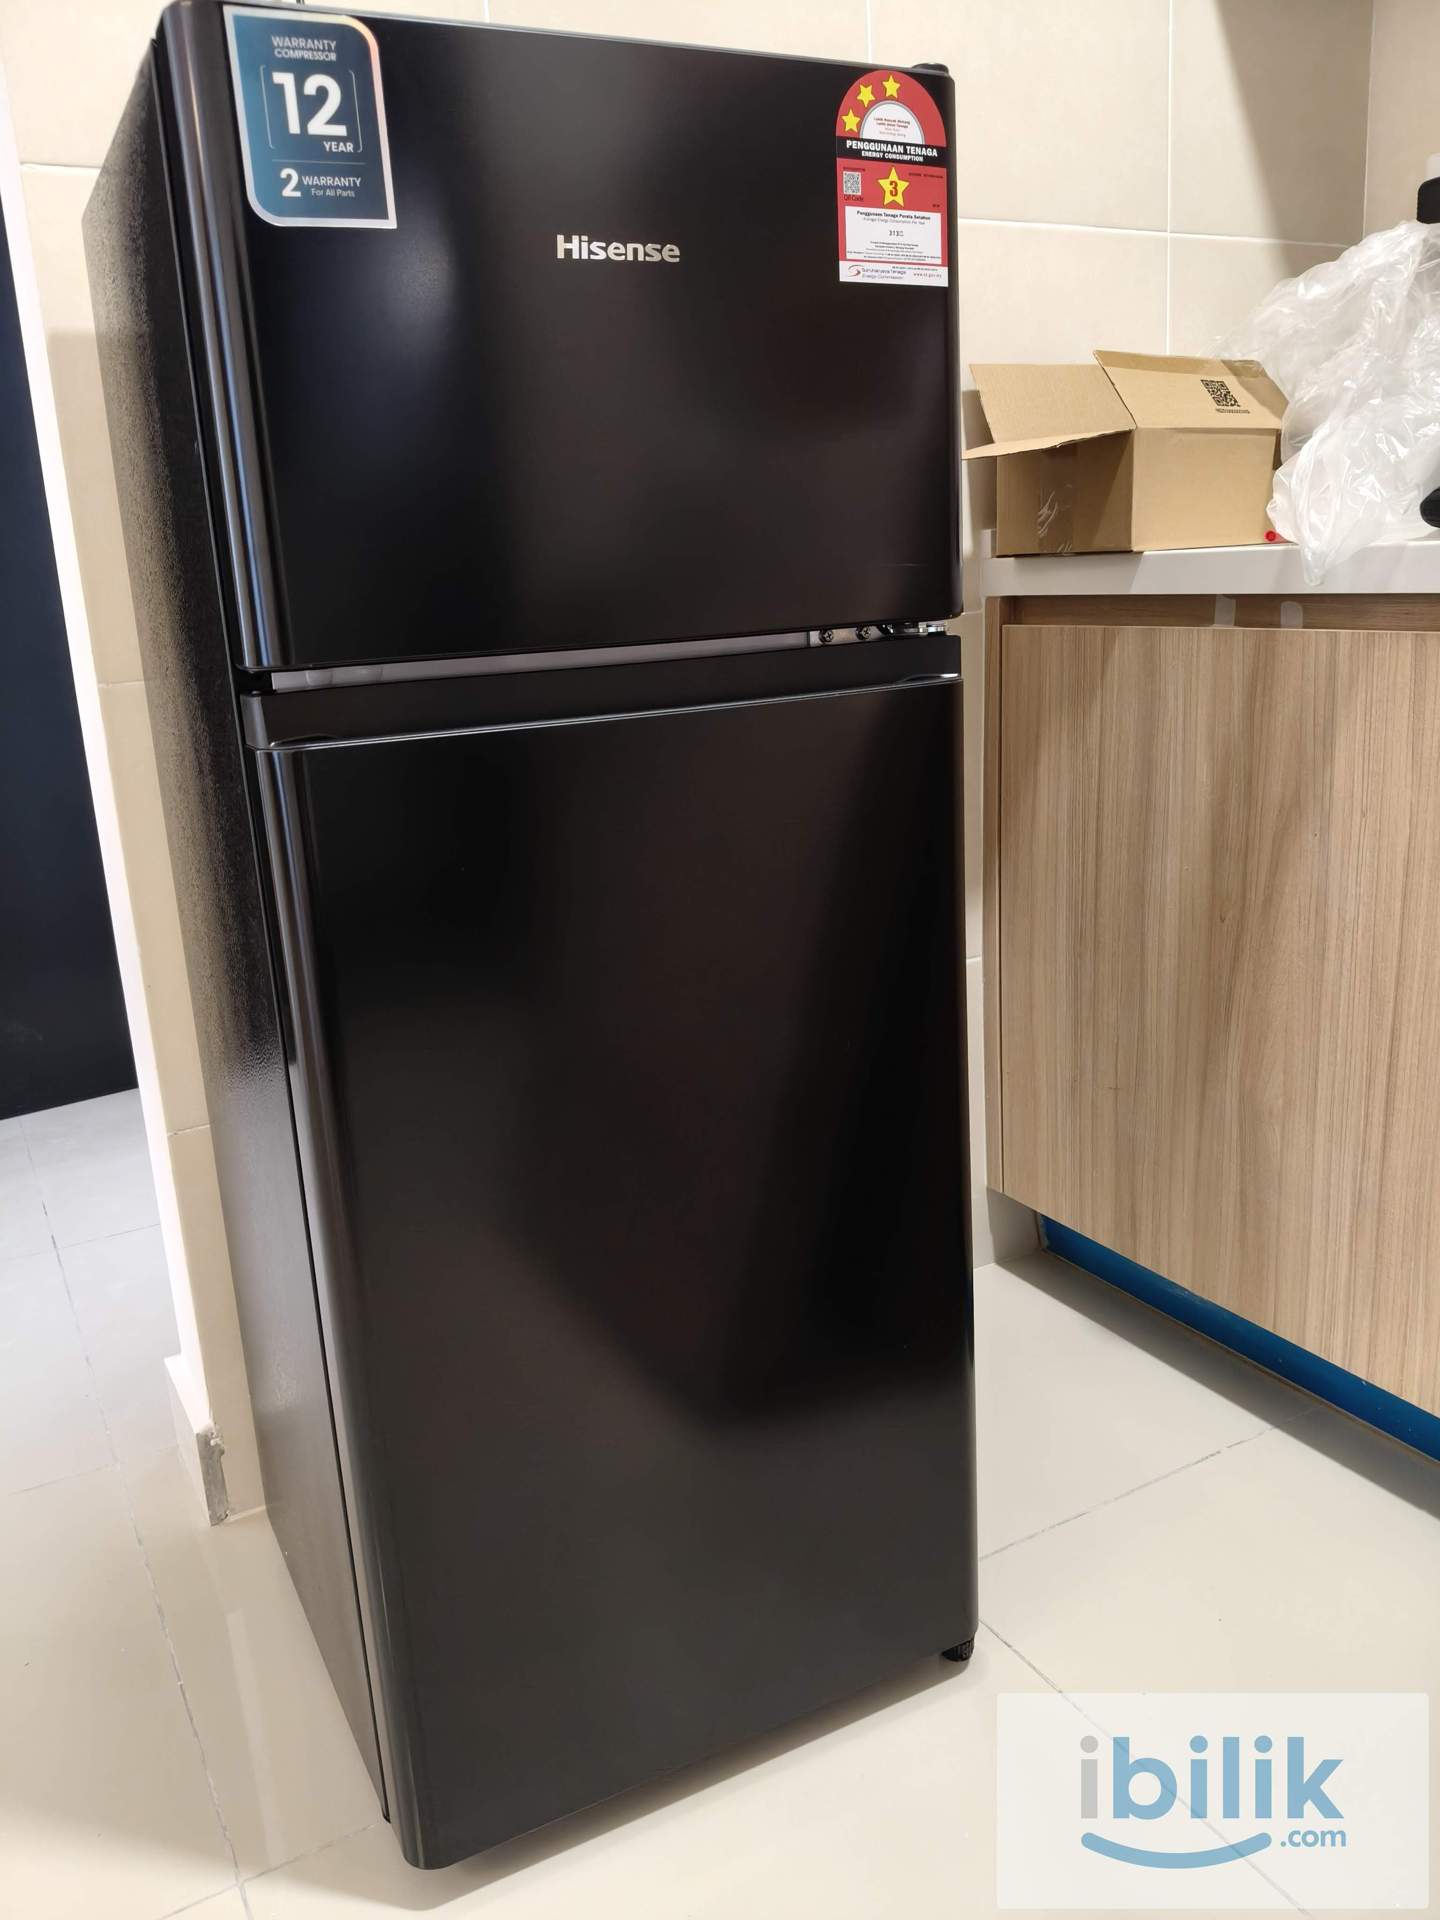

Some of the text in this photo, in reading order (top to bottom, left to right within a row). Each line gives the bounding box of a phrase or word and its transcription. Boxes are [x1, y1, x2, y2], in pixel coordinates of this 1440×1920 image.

[271, 35, 337, 50] WARRANTY
[274, 49, 337, 62] COMPRESSOR
[272, 71, 347, 137] 12
[323, 141, 354, 153] YEAR
[846, 140, 938, 157] PENGGUNAAN TENAGA
[884, 152, 924, 162] CONSUMPTION
[279, 167, 361, 198] 2 WARRANTY
[889, 180, 899, 197] 3
[311, 188, 355, 198] For All Parts
[556, 234, 681, 263] Hisense
